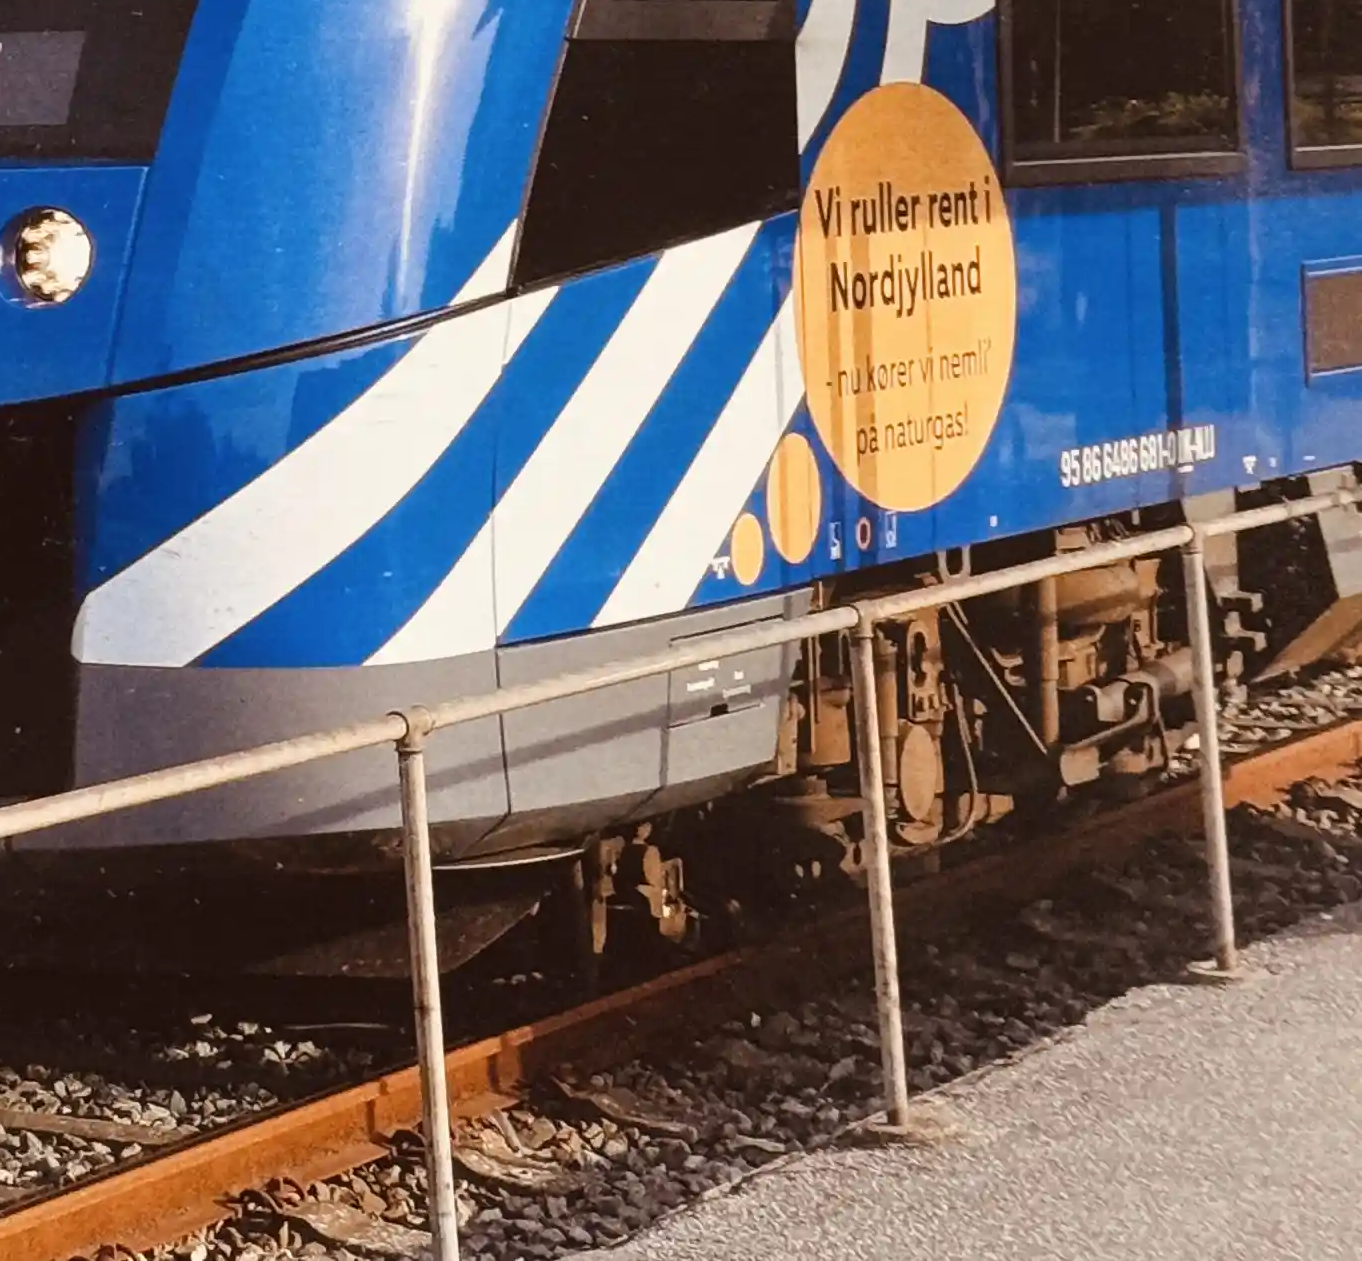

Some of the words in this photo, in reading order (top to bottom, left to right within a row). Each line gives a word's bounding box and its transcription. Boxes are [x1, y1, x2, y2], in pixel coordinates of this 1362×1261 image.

[814, 185, 842, 239] Vi
[850, 181, 921, 236] ruller
[927, 181, 979, 229] rent
[984, 174, 991, 224] i
[830, 244, 982, 318] Nordjylland
[837, 366, 861, 398] nu
[919, 345, 934, 385] vi
[1060, 449, 1081, 488] 95
[1082, 445, 1101, 484] 86
